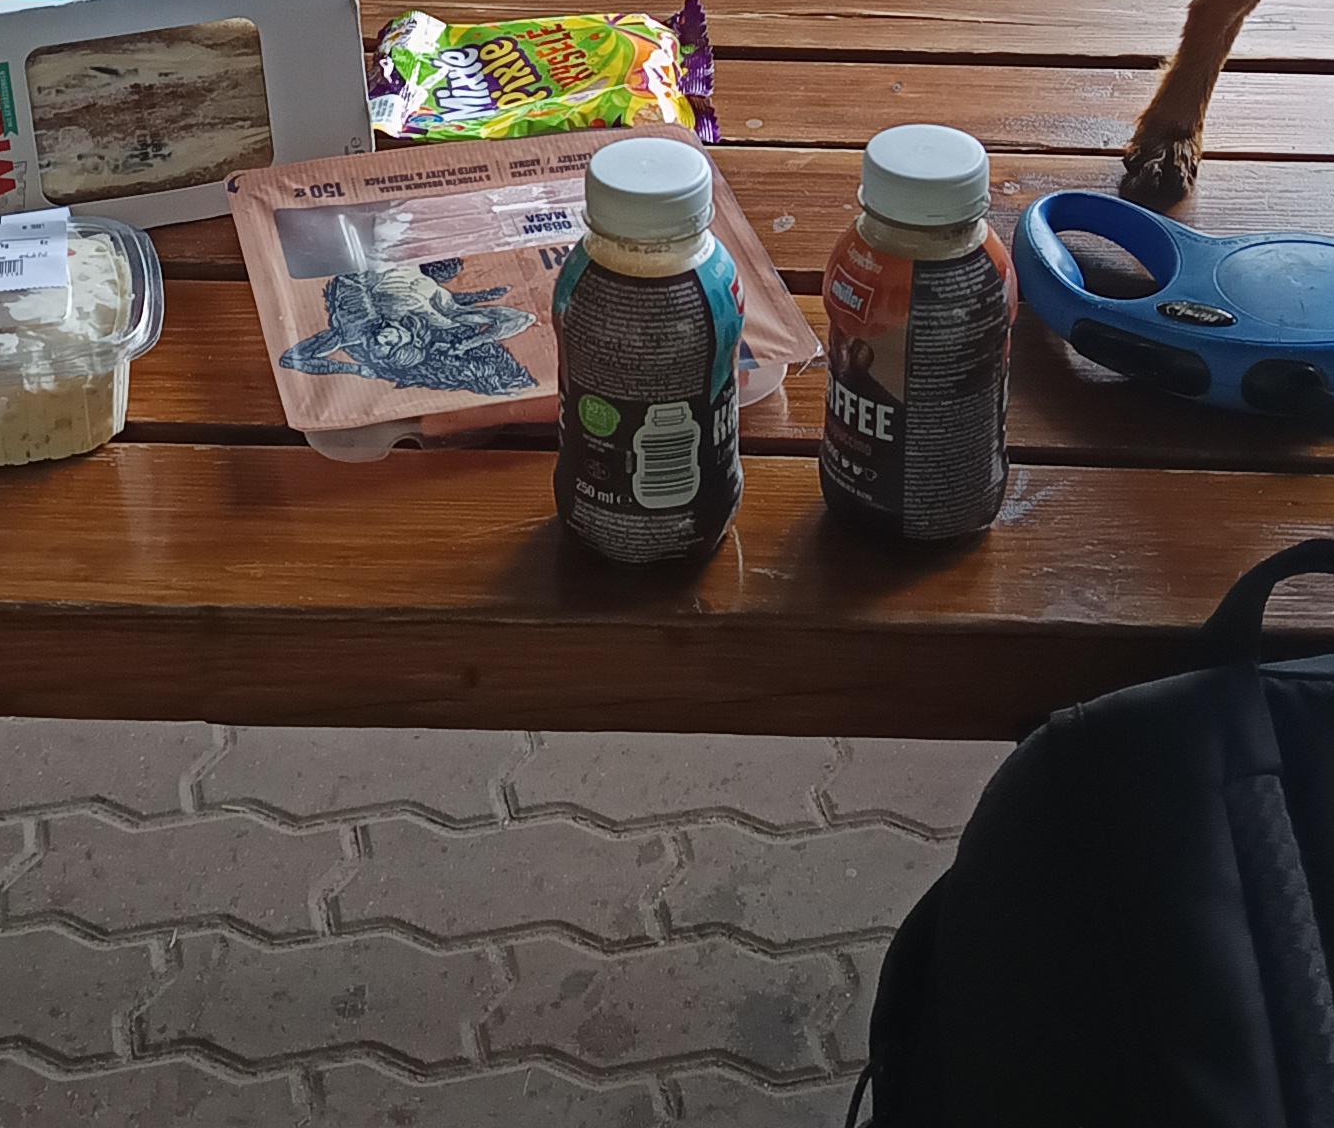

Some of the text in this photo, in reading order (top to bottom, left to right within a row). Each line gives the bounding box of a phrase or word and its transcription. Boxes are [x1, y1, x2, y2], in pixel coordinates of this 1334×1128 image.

[310, 182, 346, 198] 150
[525, 211, 568, 224] MASA
[522, 220, 573, 235] OBSAH
[575, 477, 614, 504] 250 ml
